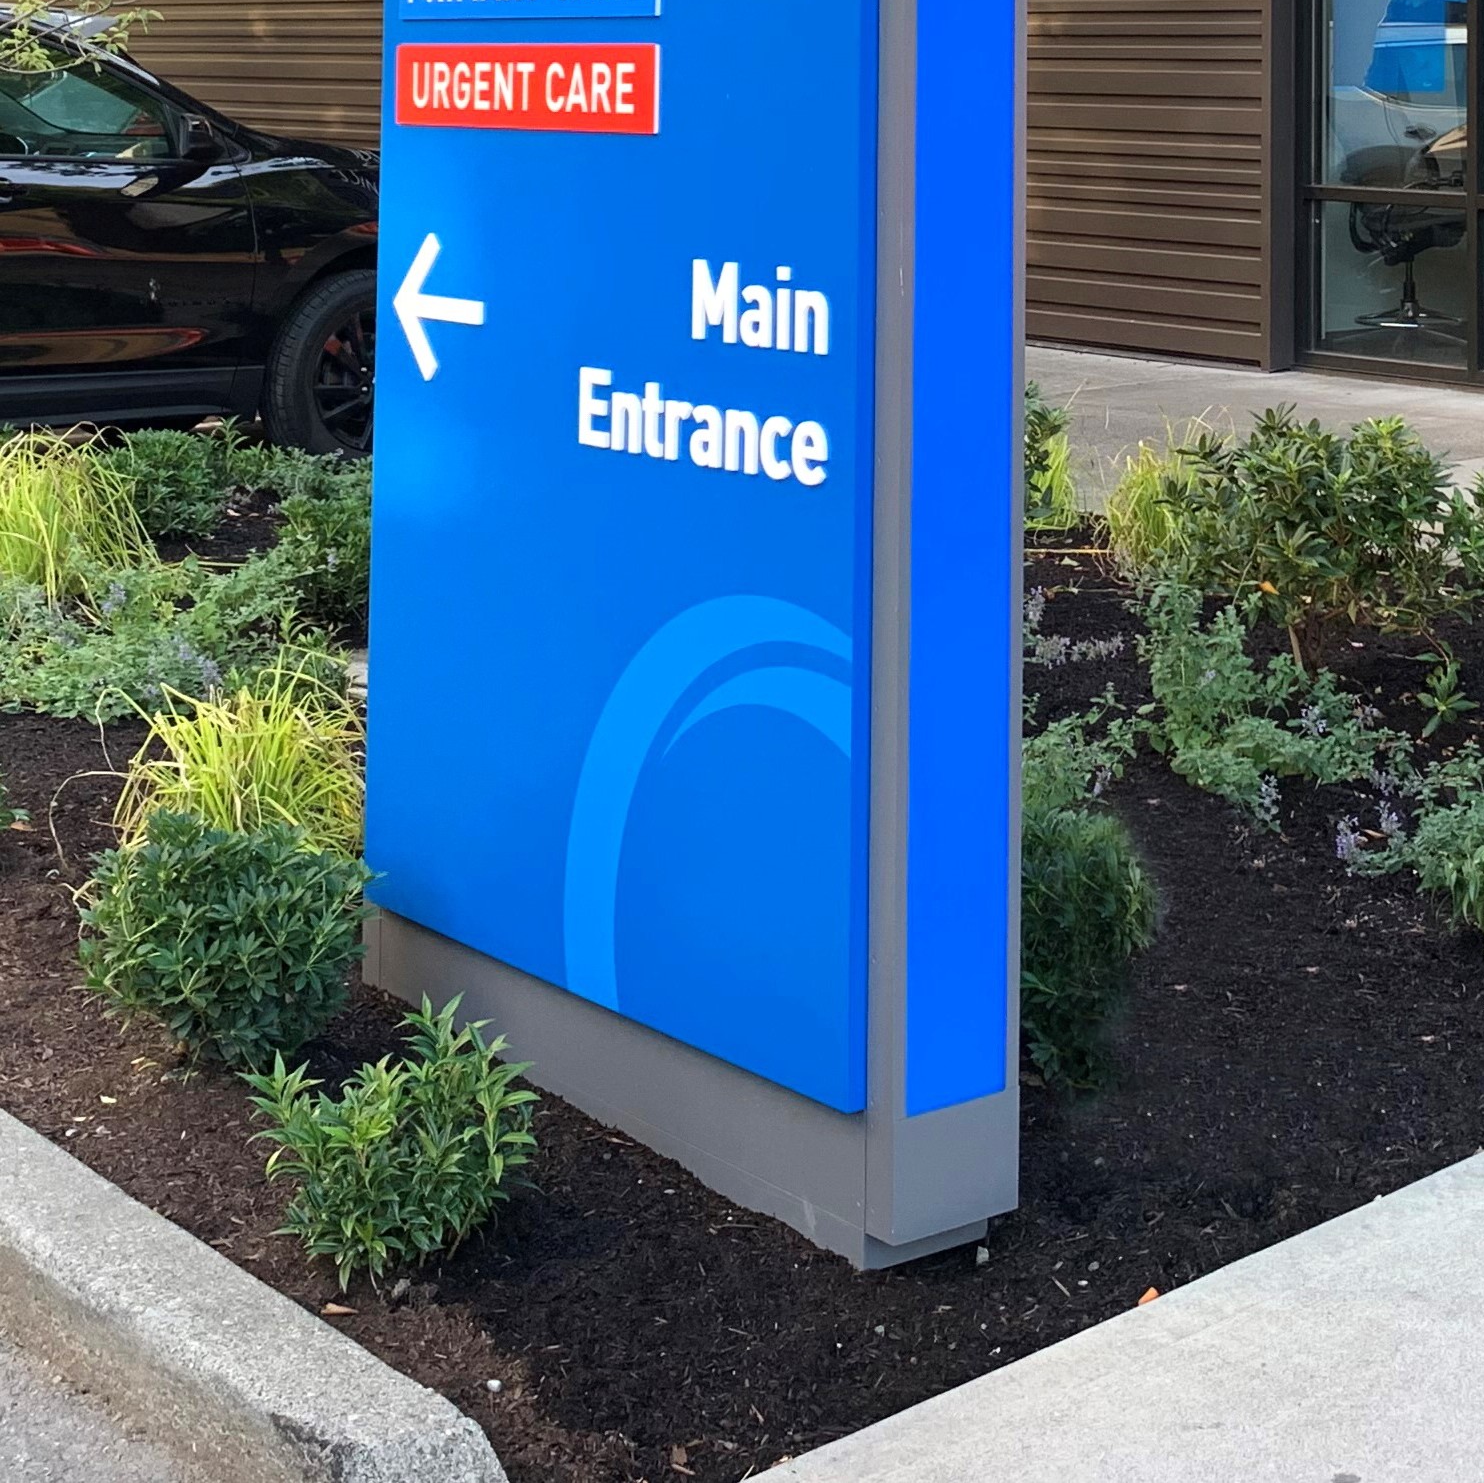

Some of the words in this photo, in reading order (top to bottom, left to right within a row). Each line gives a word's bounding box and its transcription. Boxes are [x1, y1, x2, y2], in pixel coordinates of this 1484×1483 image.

[411, 61, 535, 112] URGENT
[545, 62, 636, 114] CARE
[691, 258, 830, 356] Main
[578, 366, 829, 486] Entrance
